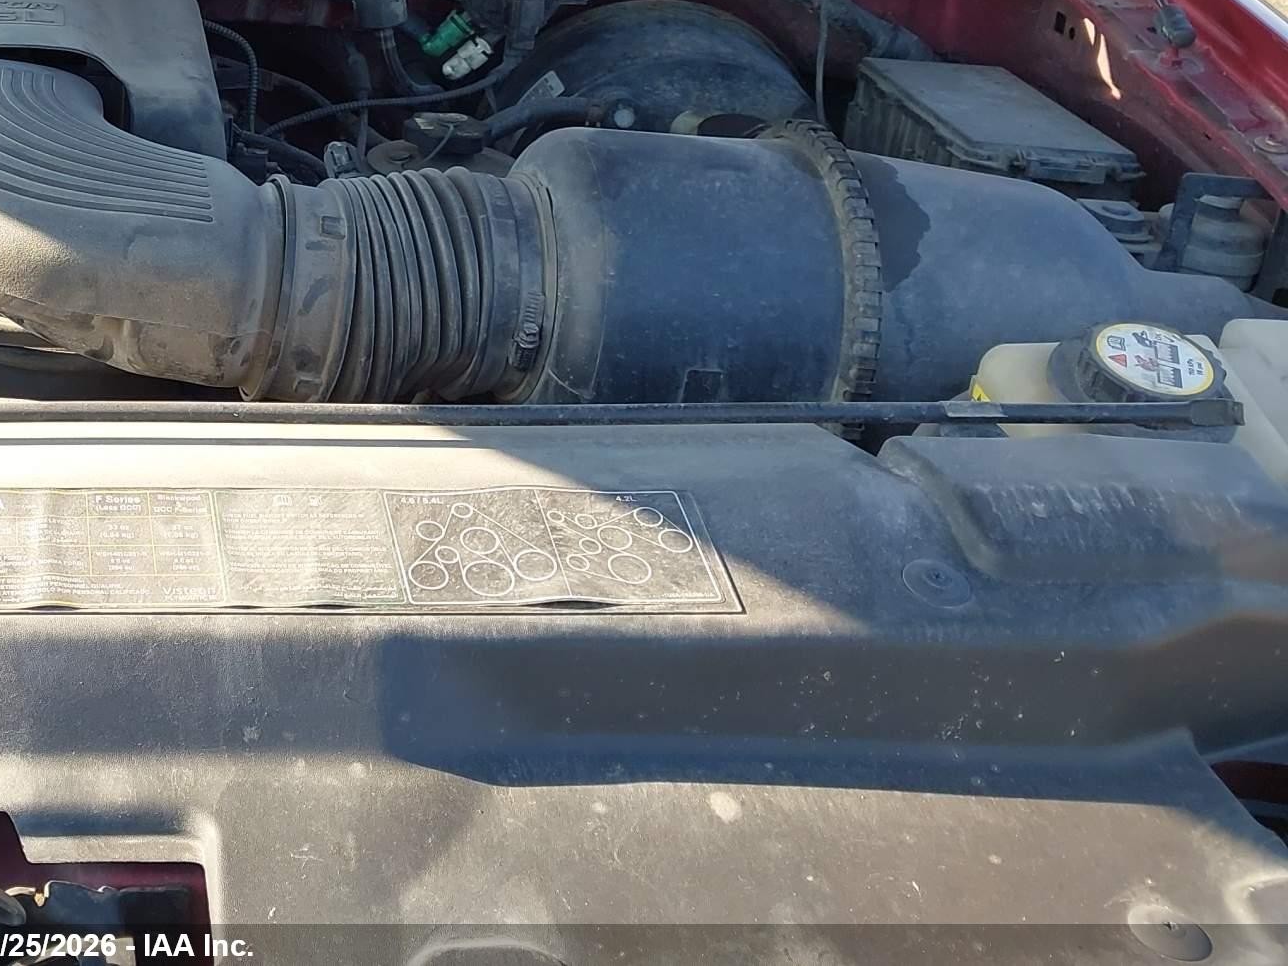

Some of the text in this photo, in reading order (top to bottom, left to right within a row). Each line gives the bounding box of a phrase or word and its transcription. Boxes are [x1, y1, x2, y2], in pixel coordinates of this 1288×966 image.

[96, 495, 142, 504] F Series
[162, 586, 217, 596] Visteon
